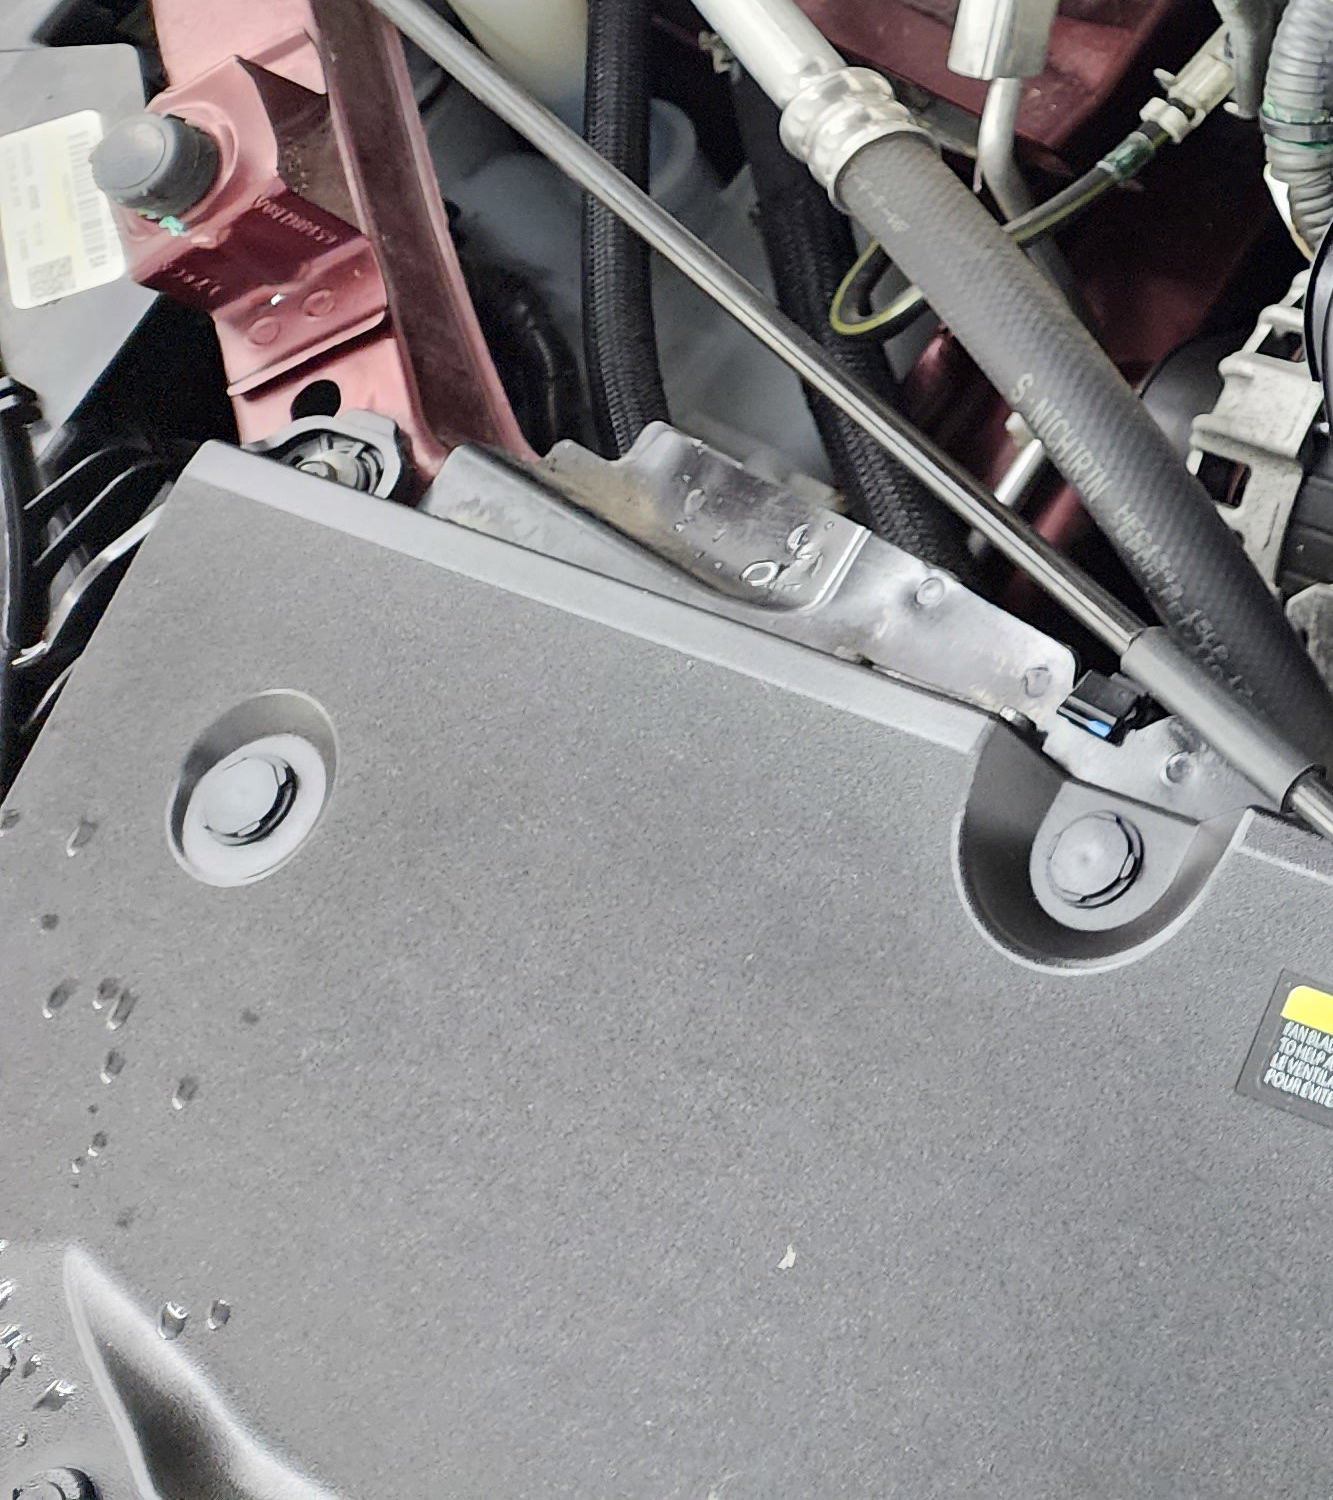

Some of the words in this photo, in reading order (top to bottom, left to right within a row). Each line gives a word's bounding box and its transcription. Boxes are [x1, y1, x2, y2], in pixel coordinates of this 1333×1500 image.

[1269, 1051, 1288, 1071] LE
[1277, 1035, 1296, 1055] TO
[1294, 1042, 1325, 1066] HELP
[1263, 1066, 1300, 1094] POUR
